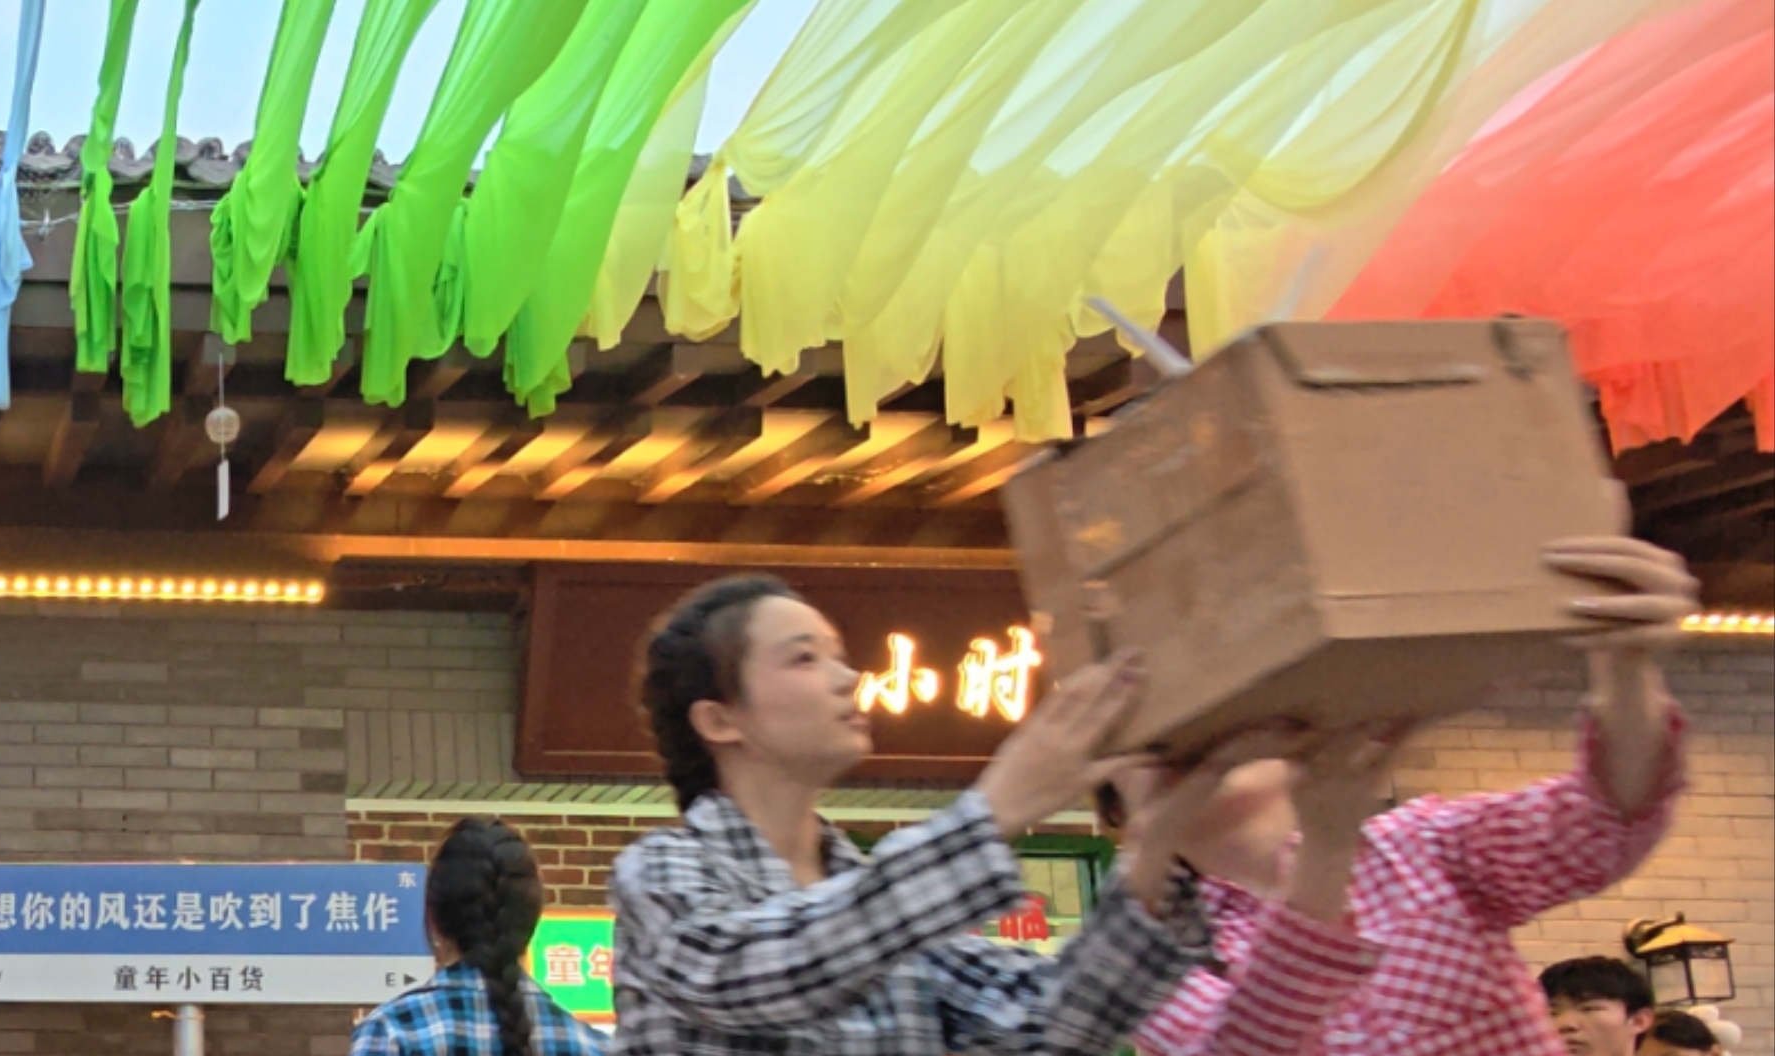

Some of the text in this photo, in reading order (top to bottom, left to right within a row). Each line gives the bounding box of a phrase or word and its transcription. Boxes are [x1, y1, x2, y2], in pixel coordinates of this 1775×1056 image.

[855, 625, 1041, 721] 小时
[398, 872, 417, 889] 东
[113, 966, 265, 992] 童年小百货
[385, 972, 396, 987] E
